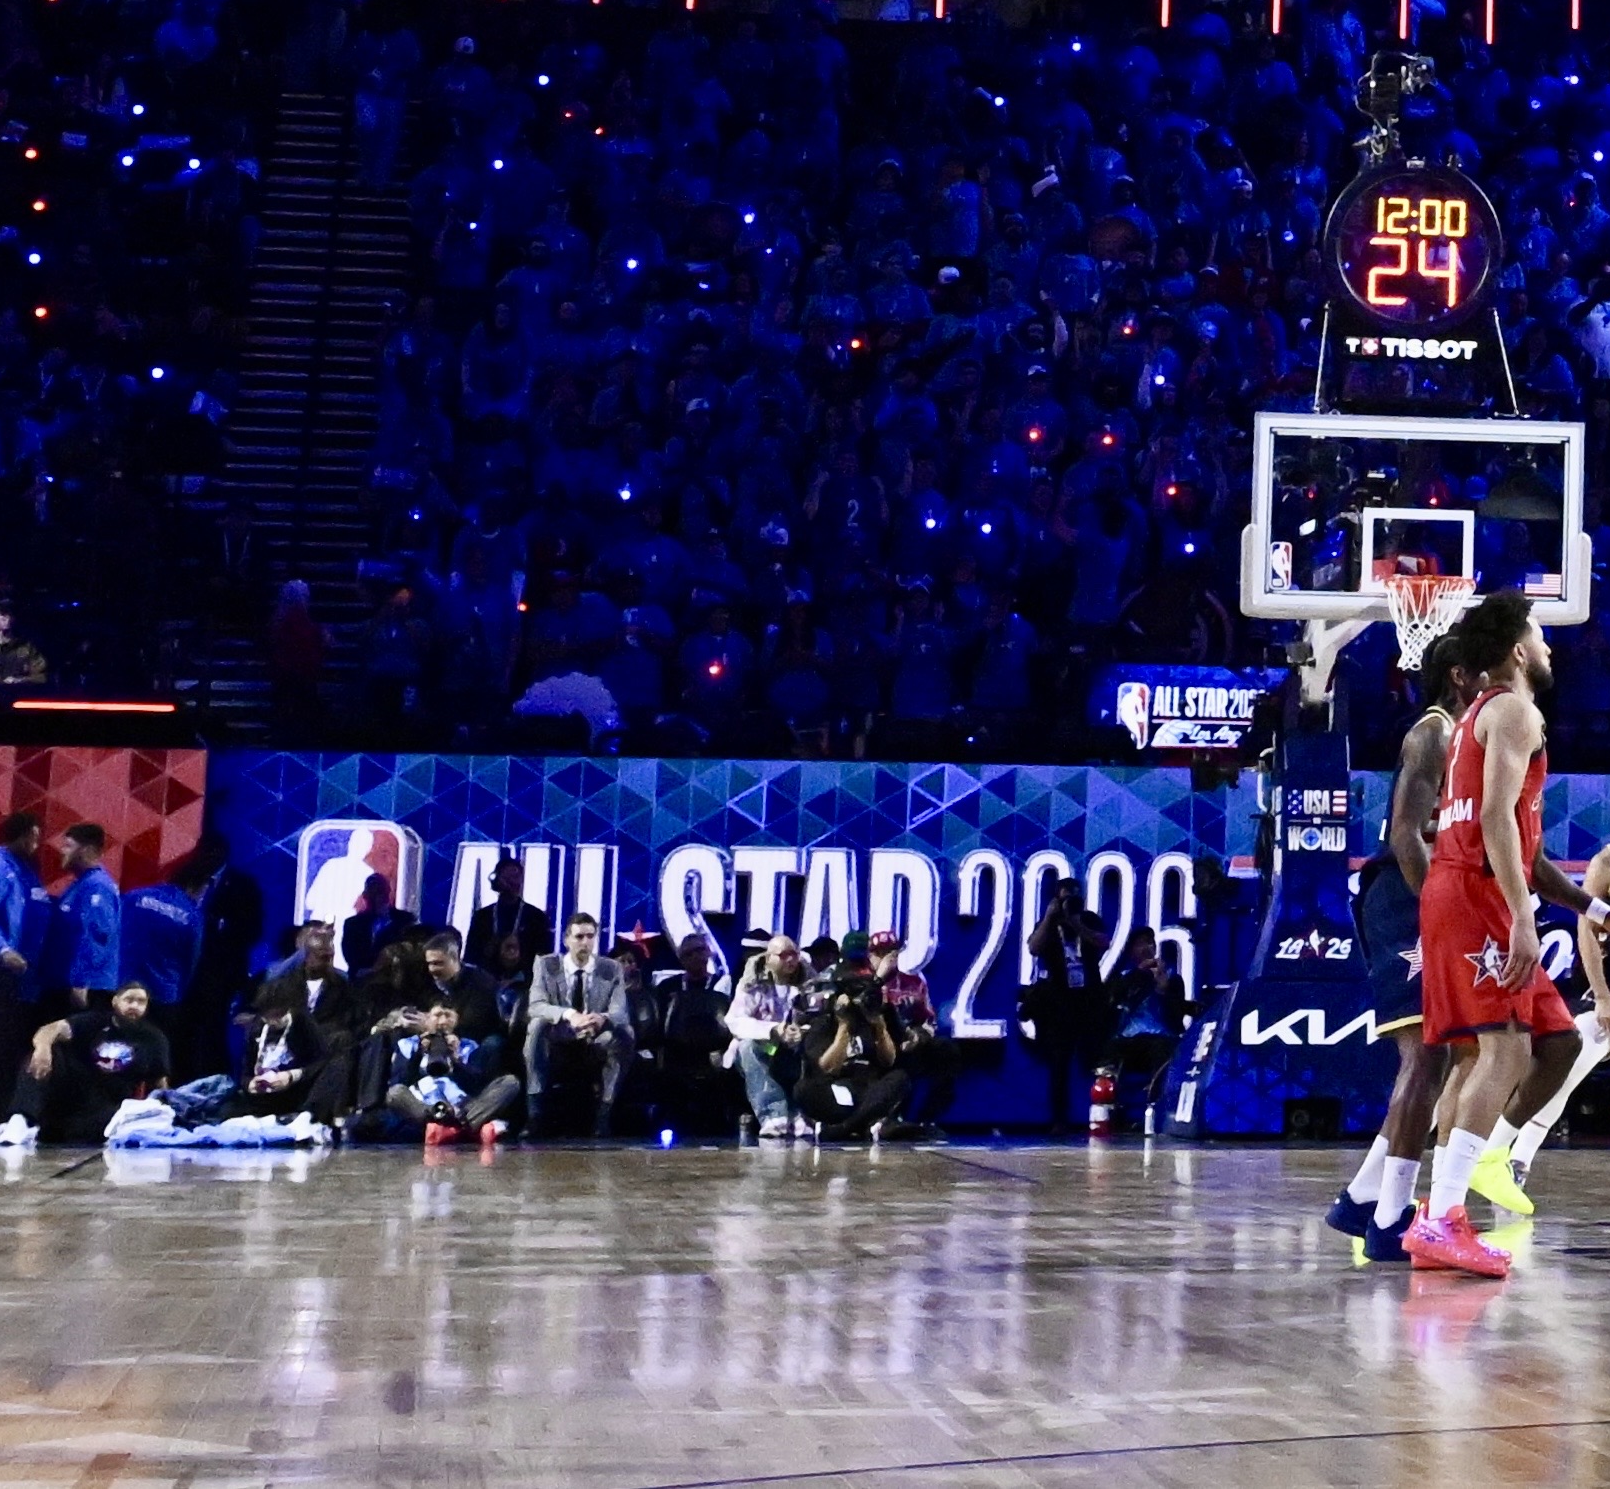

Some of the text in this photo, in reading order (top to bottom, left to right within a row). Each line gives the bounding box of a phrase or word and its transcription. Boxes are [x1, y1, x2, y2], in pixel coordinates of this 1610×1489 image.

[1377, 196, 1467, 238] 12:00
[1367, 238, 1457, 308] 24
[1382, 339, 1478, 360] TISSOT
[1153, 686, 1228, 718] ALL STAR
[1303, 790, 1330, 815] USA
[1288, 827, 1346, 852] WORLD
[952, 848, 1198, 1040] 2026
[1327, 938, 1352, 959] 26
